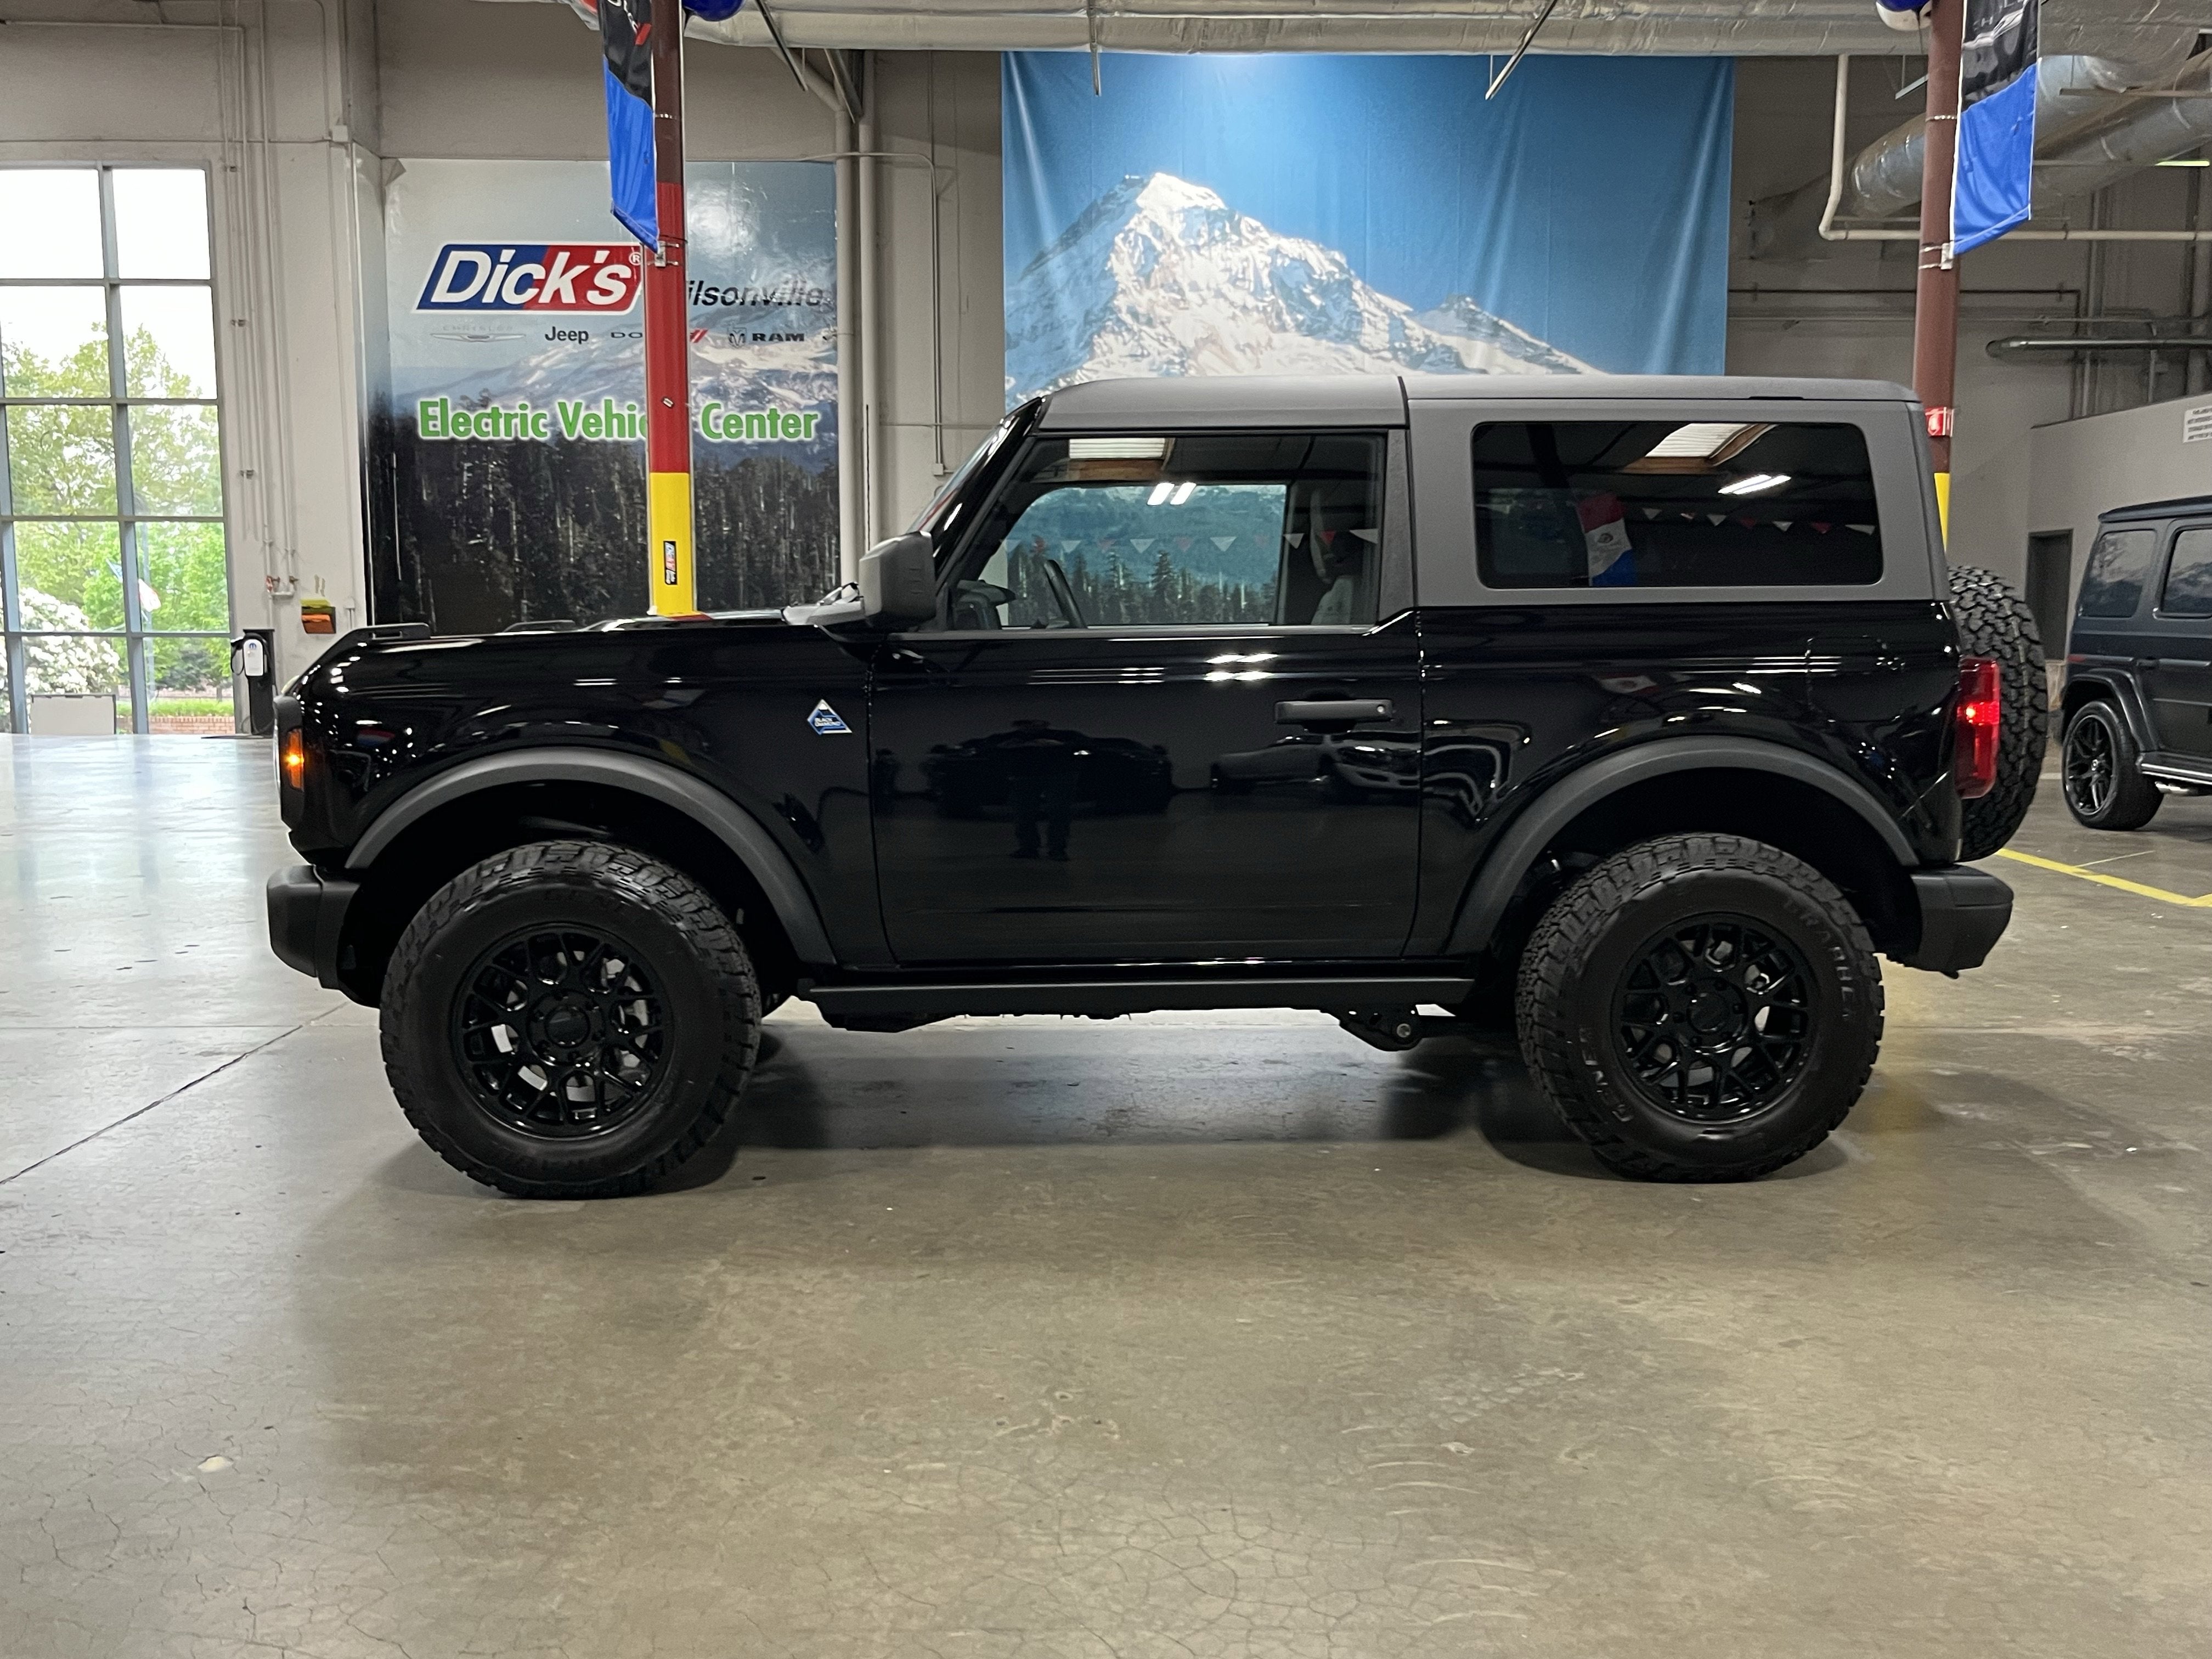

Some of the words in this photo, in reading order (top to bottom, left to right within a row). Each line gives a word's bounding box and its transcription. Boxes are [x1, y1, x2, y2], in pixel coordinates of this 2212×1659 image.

[689, 279, 824, 306] ilsonville
[545, 326, 589, 344] Jeep
[752, 332, 805, 342] RAM
[420, 398, 548, 438] Electric
[702, 403, 818, 439] Center
